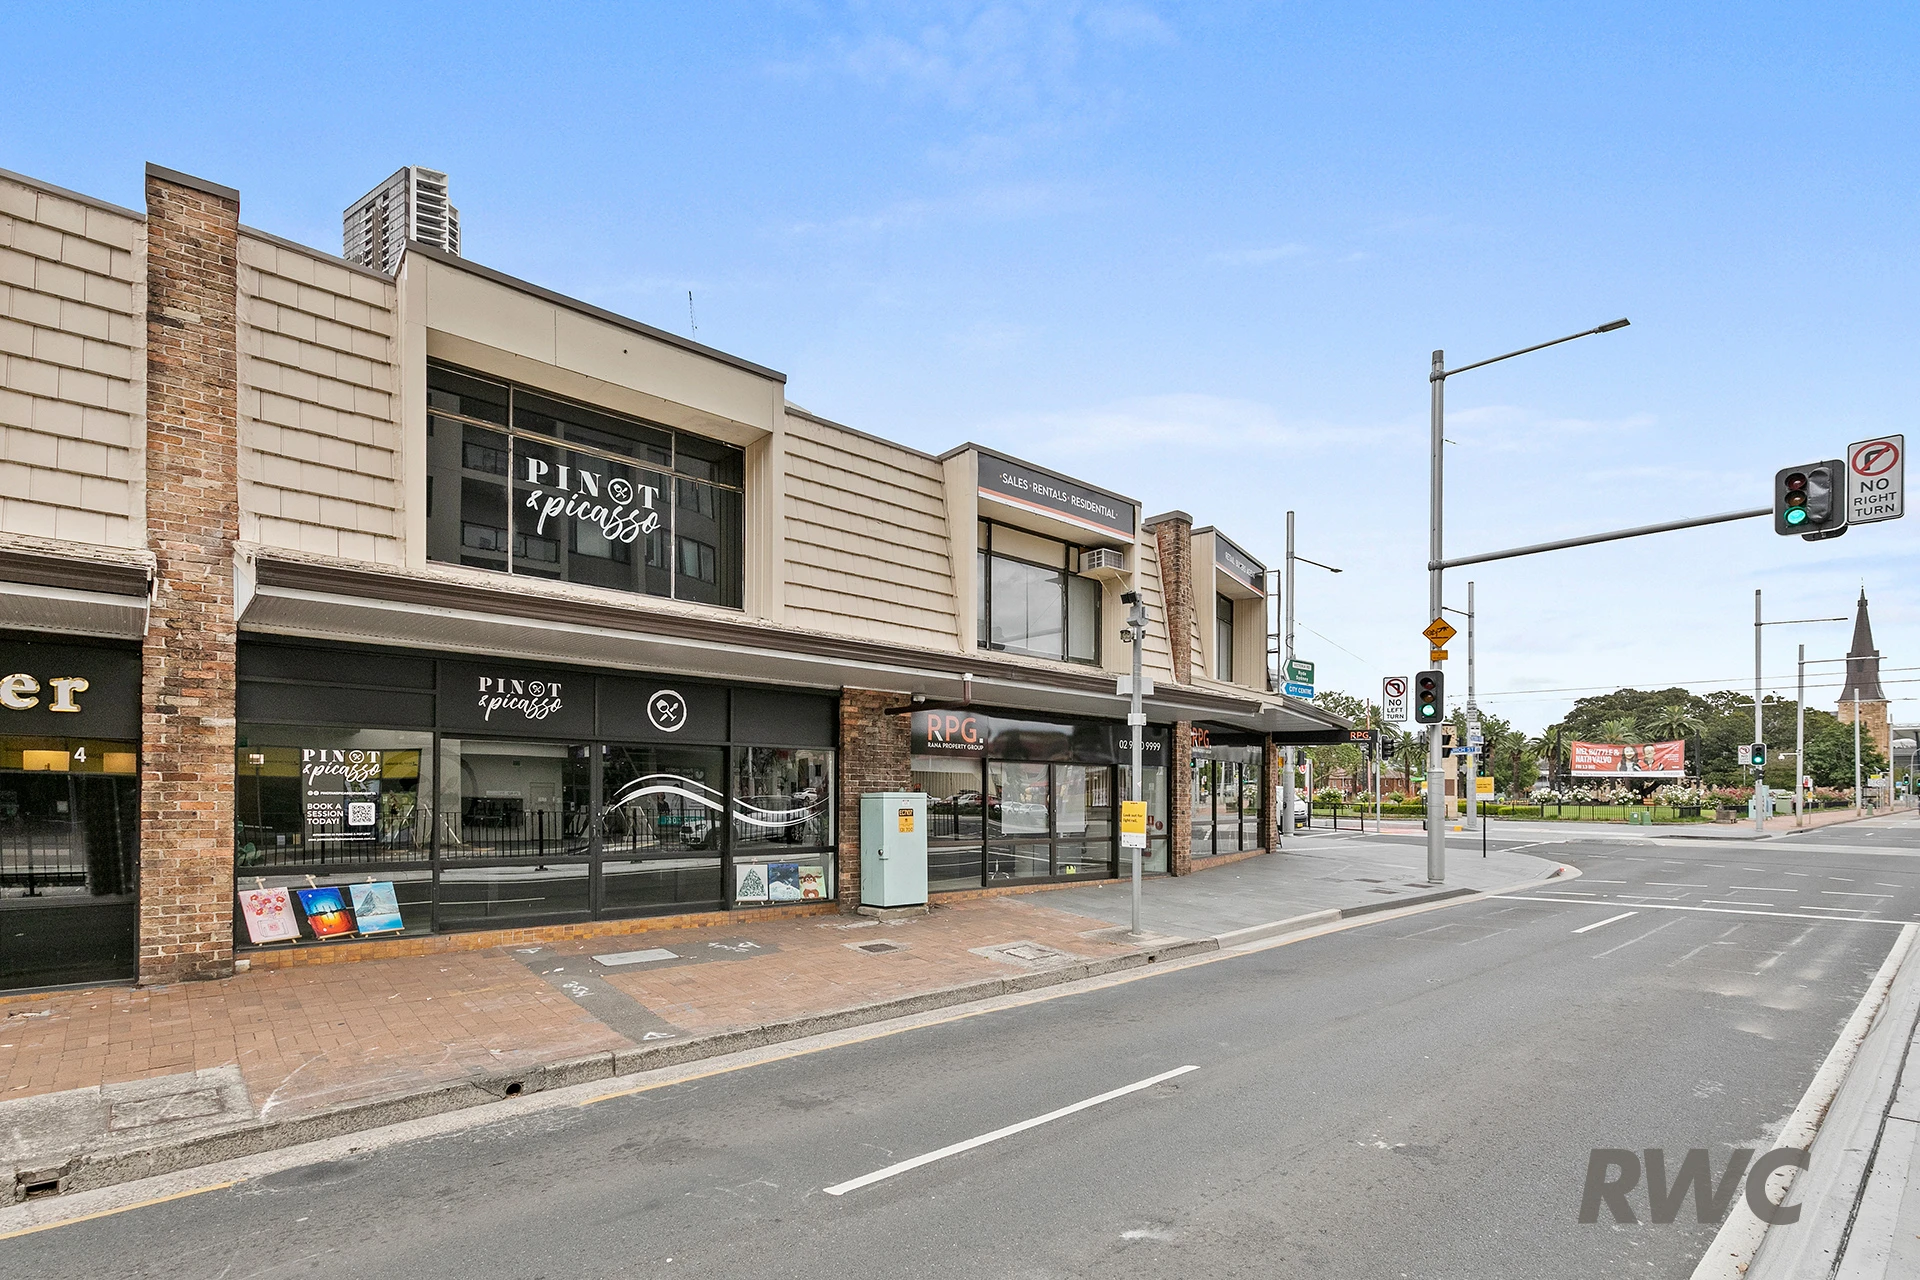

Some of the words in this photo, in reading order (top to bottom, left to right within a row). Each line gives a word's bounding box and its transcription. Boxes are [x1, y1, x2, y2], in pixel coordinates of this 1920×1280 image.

[525, 456, 660, 510] PINOT
[1860, 477, 1890, 493] NO
[1002, 472, 1029, 491] SALES
[1032, 482, 1067, 503] RENTALS
[1071, 494, 1116, 520] RESIDENTIAL
[1854, 492, 1897, 506] RIGHT
[1855, 503, 1895, 517] TURN
[478, 676, 562, 698] PINOT
[1388, 698, 1402, 707] NO
[927, 741, 942, 749] RANA
[942, 742, 967, 750] PROPERTY
[966, 743, 984, 751] GROUP
[1118, 739, 1128, 750] 02
[1145, 741, 1161, 752] 9999
[73, 746, 87, 763] 4
[302, 748, 380, 764] PINOT
[306, 810, 344, 818] SESSION
